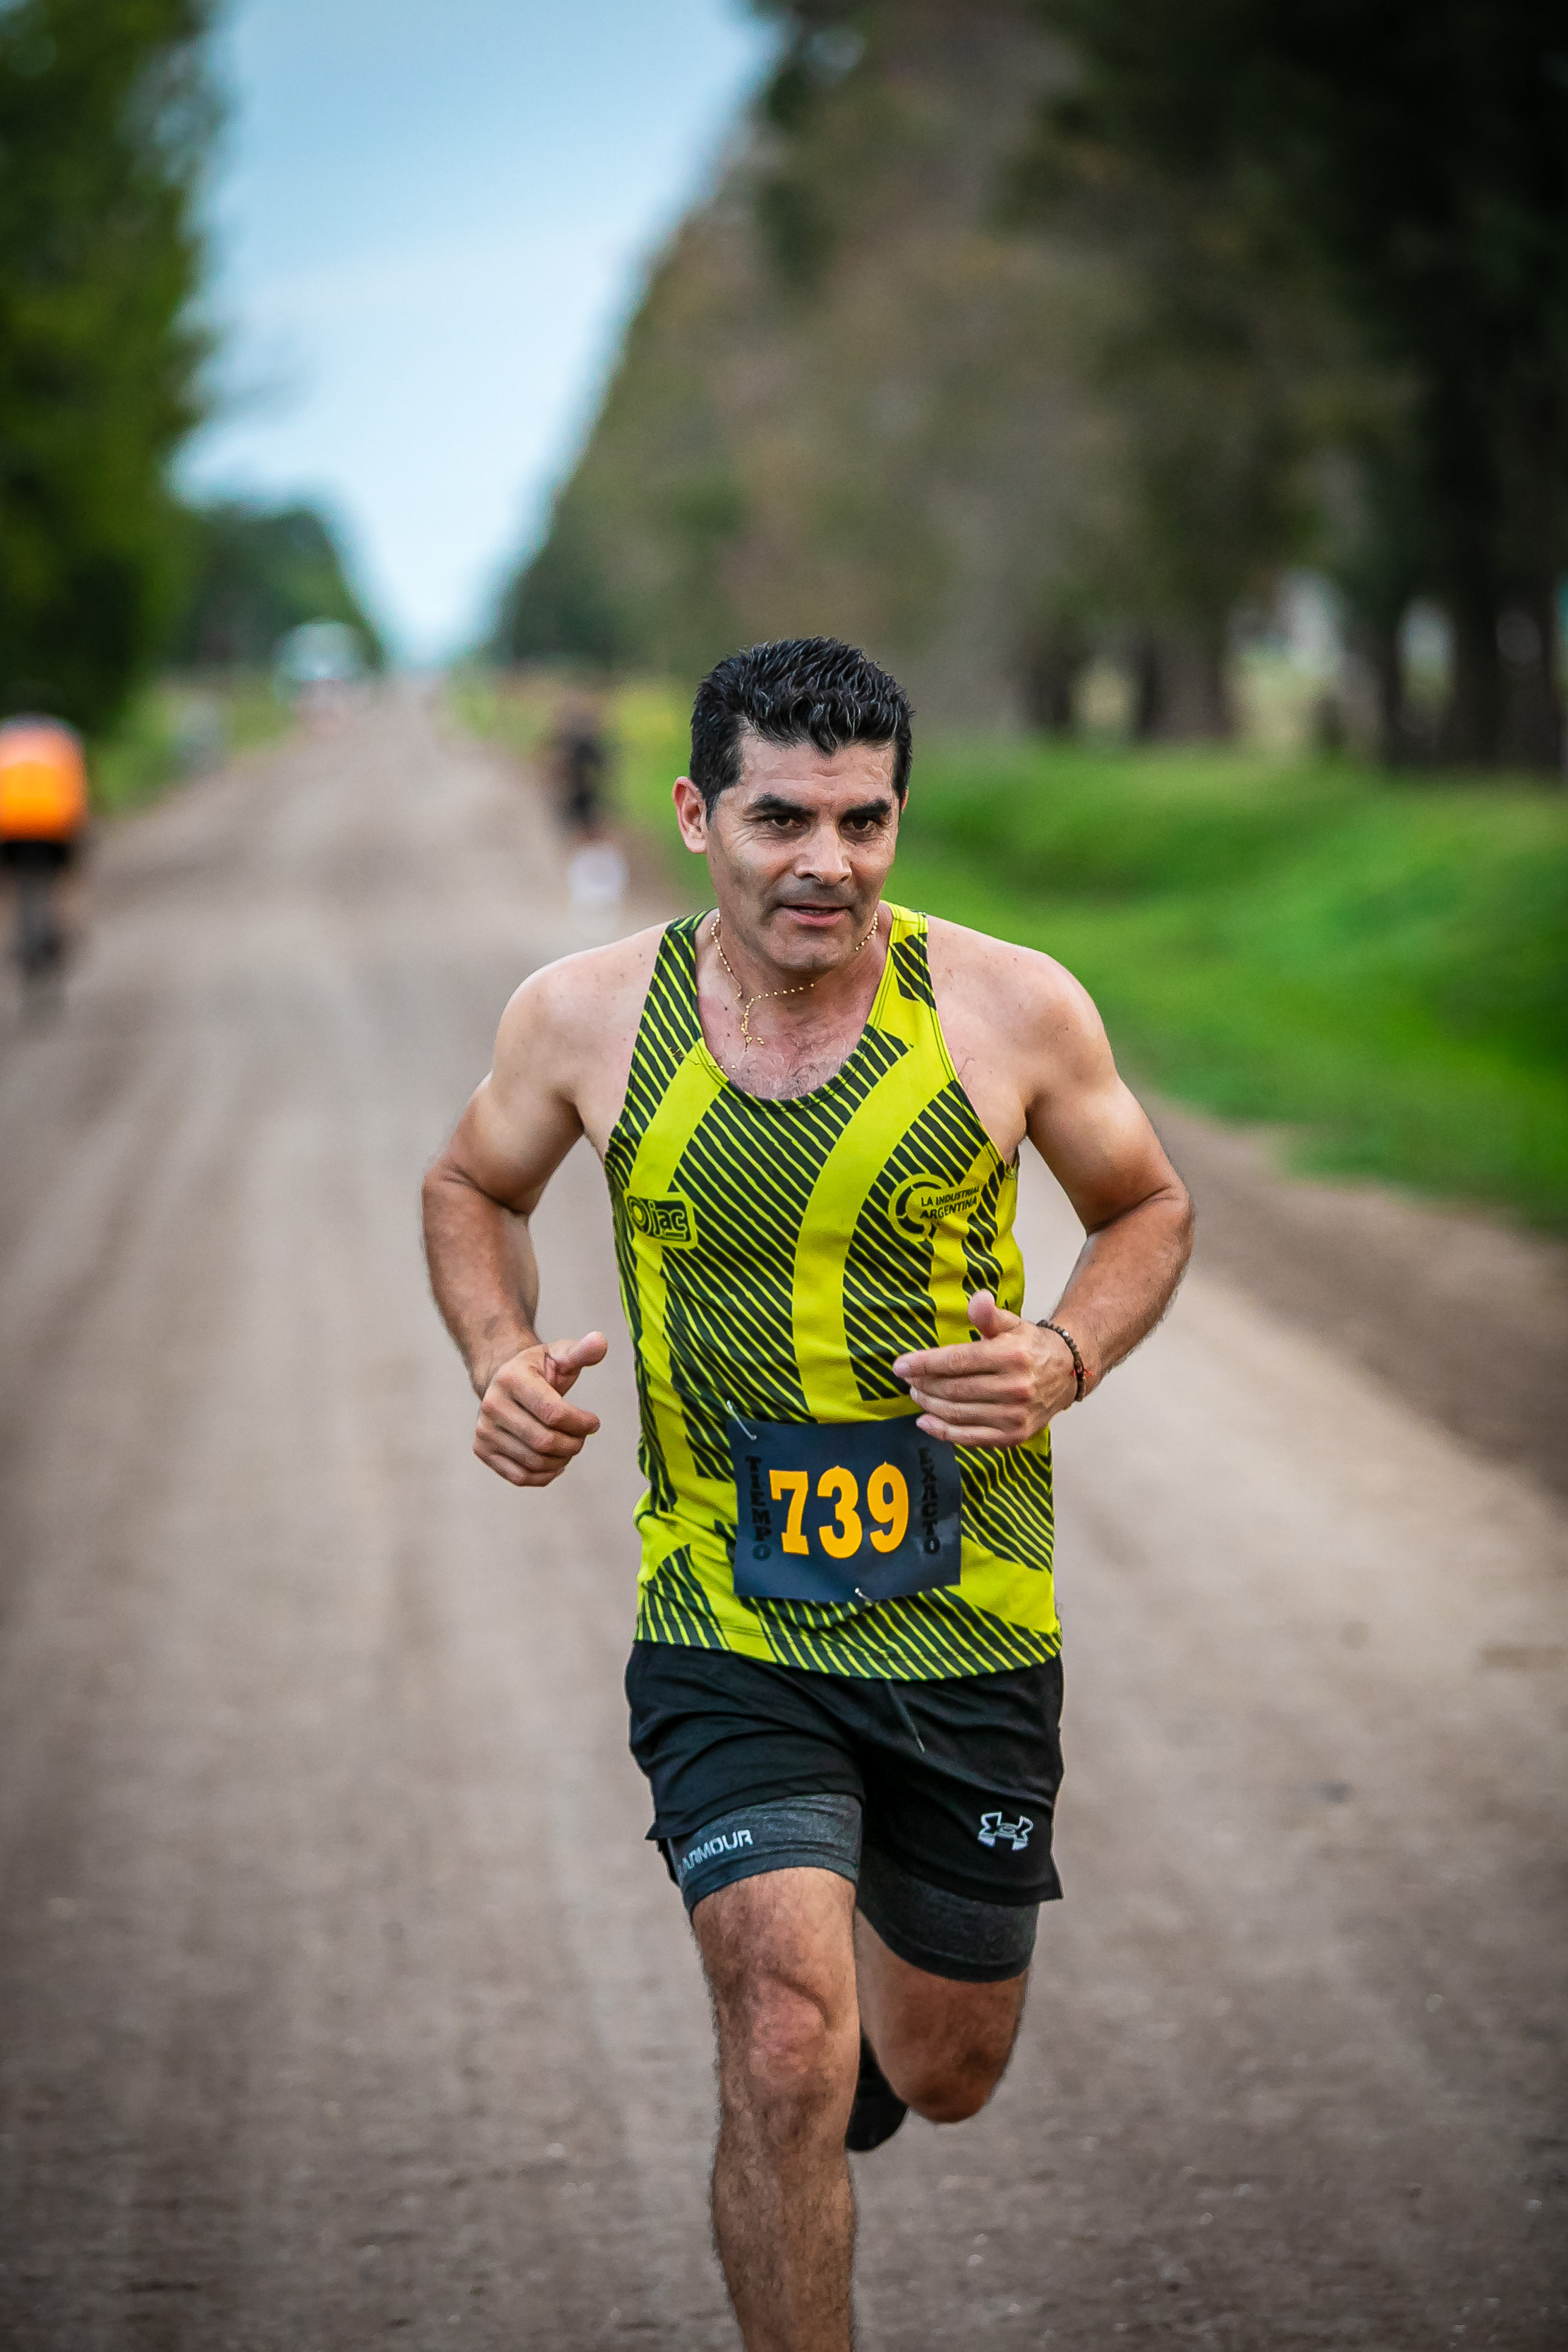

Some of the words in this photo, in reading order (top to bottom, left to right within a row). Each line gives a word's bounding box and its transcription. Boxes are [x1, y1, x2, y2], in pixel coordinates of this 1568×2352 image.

[920, 1194, 977, 1219] ARGENTINA
[921, 1196, 933, 1207] LA
[745, 1455, 772, 1560] TIEMPO
[770, 1461, 908, 1558] 739
[918, 1447, 941, 1554] EXACTO
